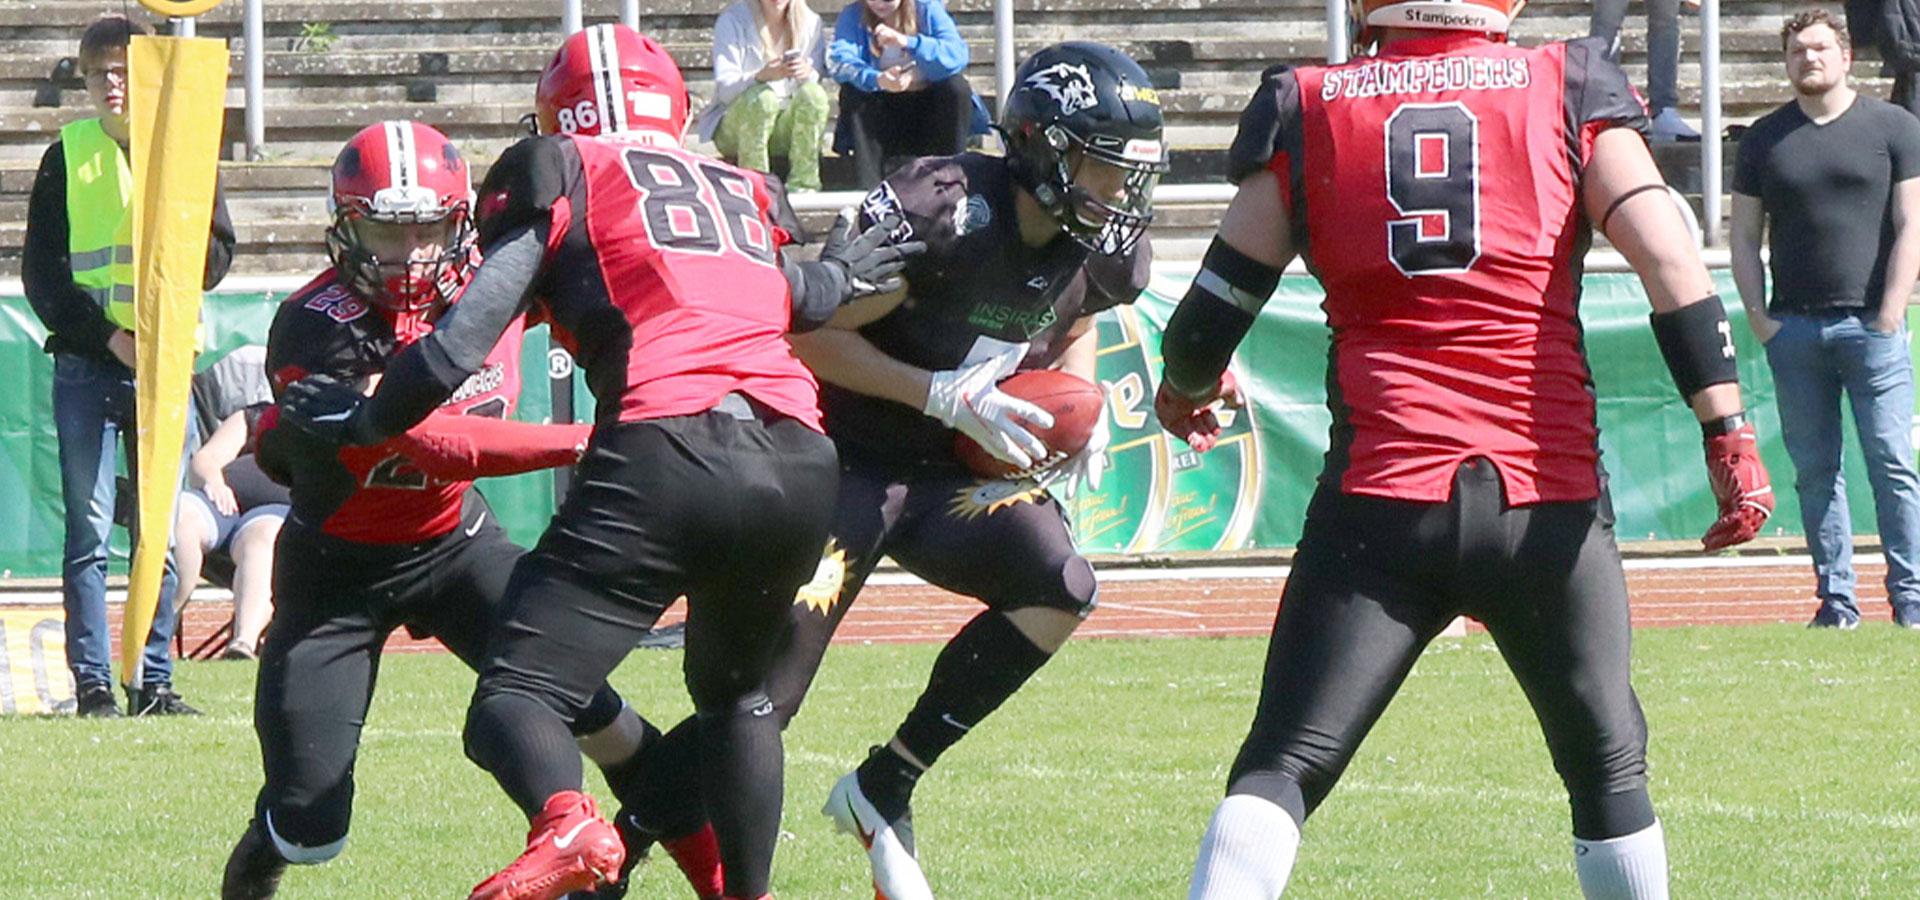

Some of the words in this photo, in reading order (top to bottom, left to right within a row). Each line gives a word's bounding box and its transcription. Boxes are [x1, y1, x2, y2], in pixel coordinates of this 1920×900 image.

[1405, 8, 1486, 27] Stampeders
[1322, 58, 1531, 100] STAMPEDERS
[557, 100, 598, 134] 86
[1385, 101, 1481, 276] 9
[304, 284, 369, 324] 29
